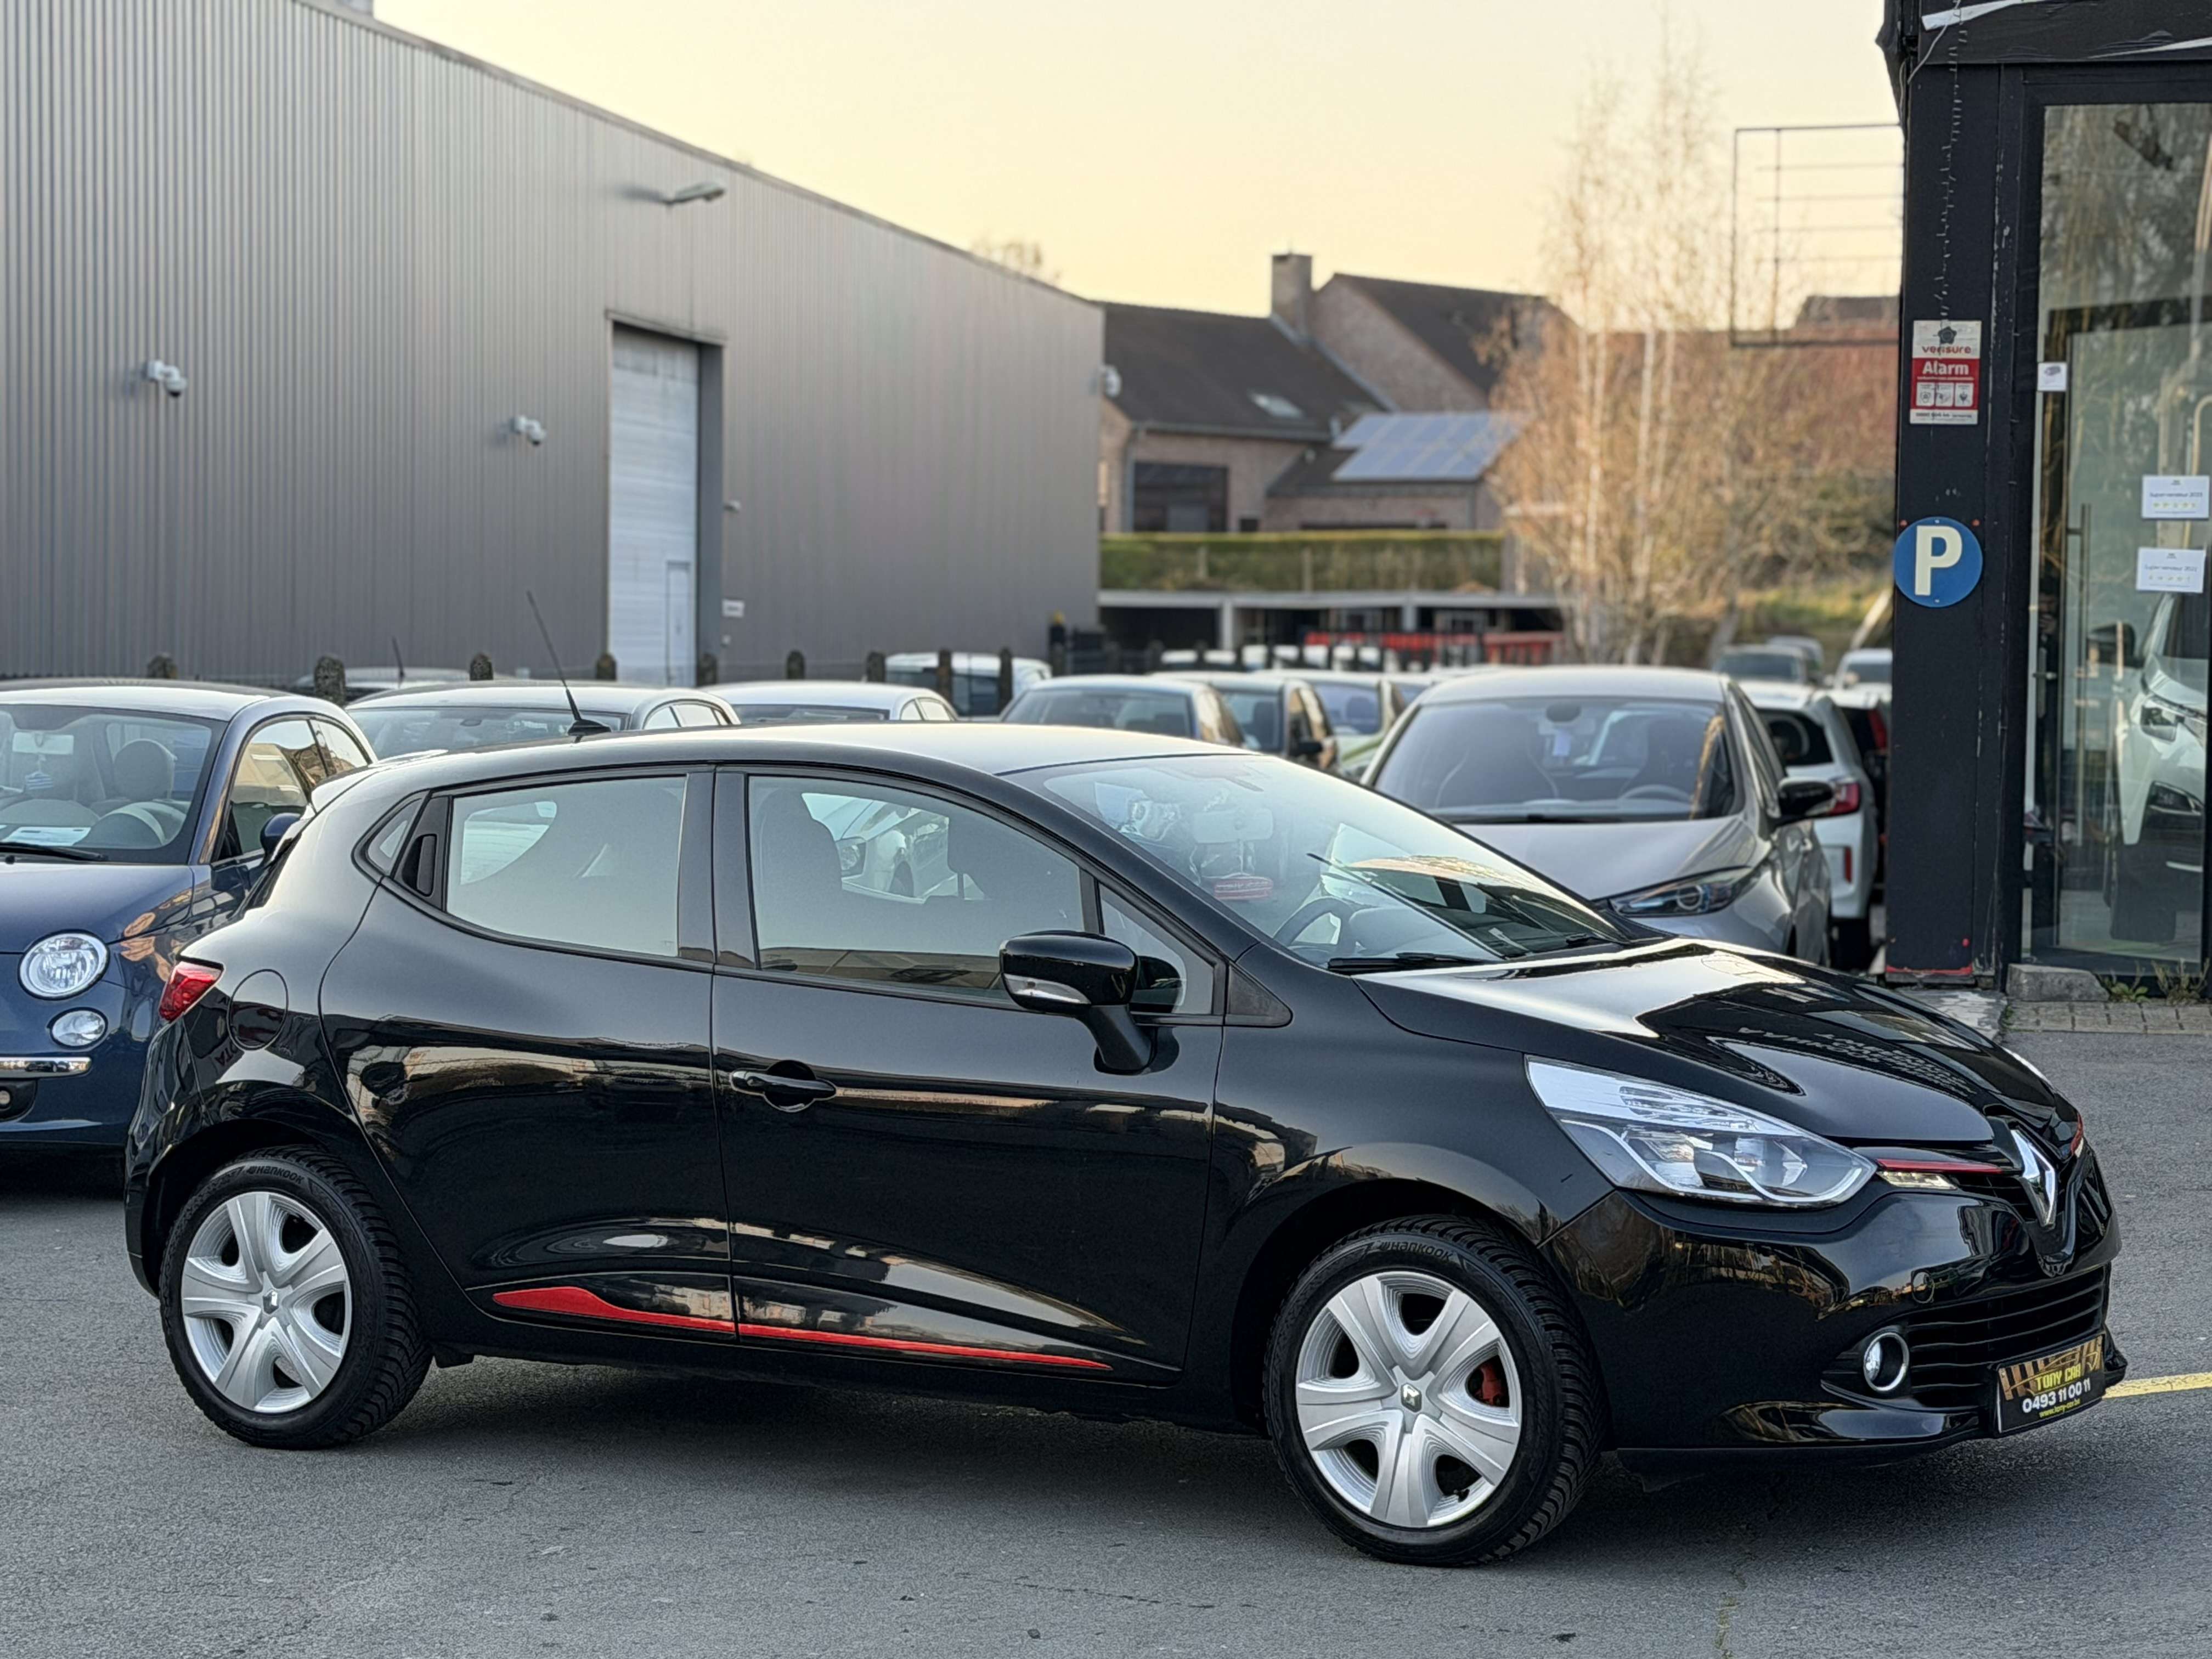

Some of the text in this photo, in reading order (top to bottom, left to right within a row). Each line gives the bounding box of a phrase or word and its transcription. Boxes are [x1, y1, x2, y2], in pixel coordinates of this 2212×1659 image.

[1922, 346, 1972, 354] verisure
[1922, 360, 1970, 375] Alarm
[1915, 524, 1962, 596] P
[2035, 1363, 2081, 1391] TONY CAR
[2022, 1377, 2091, 1414] 0493 11 00 11
